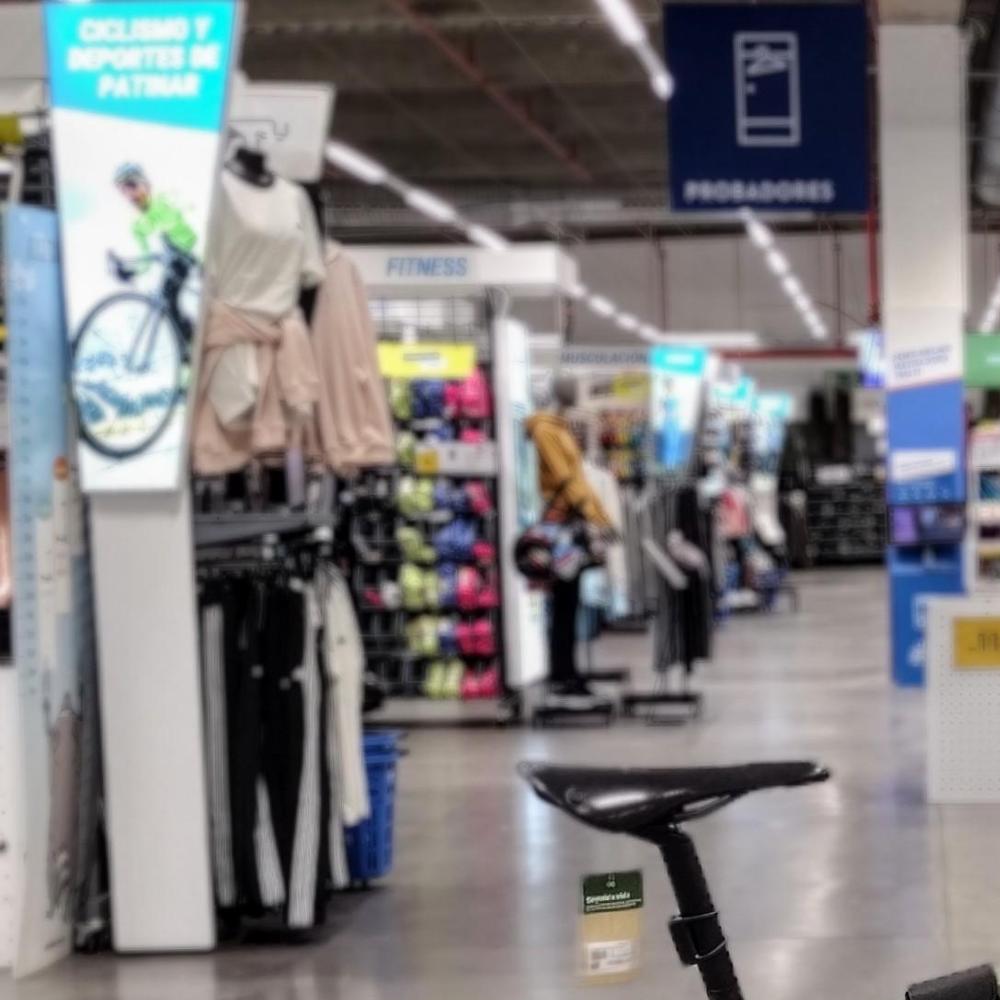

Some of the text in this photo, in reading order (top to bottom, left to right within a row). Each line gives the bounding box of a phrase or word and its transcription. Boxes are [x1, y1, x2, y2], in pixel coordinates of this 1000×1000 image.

[80, 16, 212, 42] CICLISMO Y
[67, 43, 220, 71] DEPORTES DE
[98, 73, 200, 99] PATINAR
[683, 179, 835, 202] PROBADORES
[386, 256, 468, 276] FITNESS
